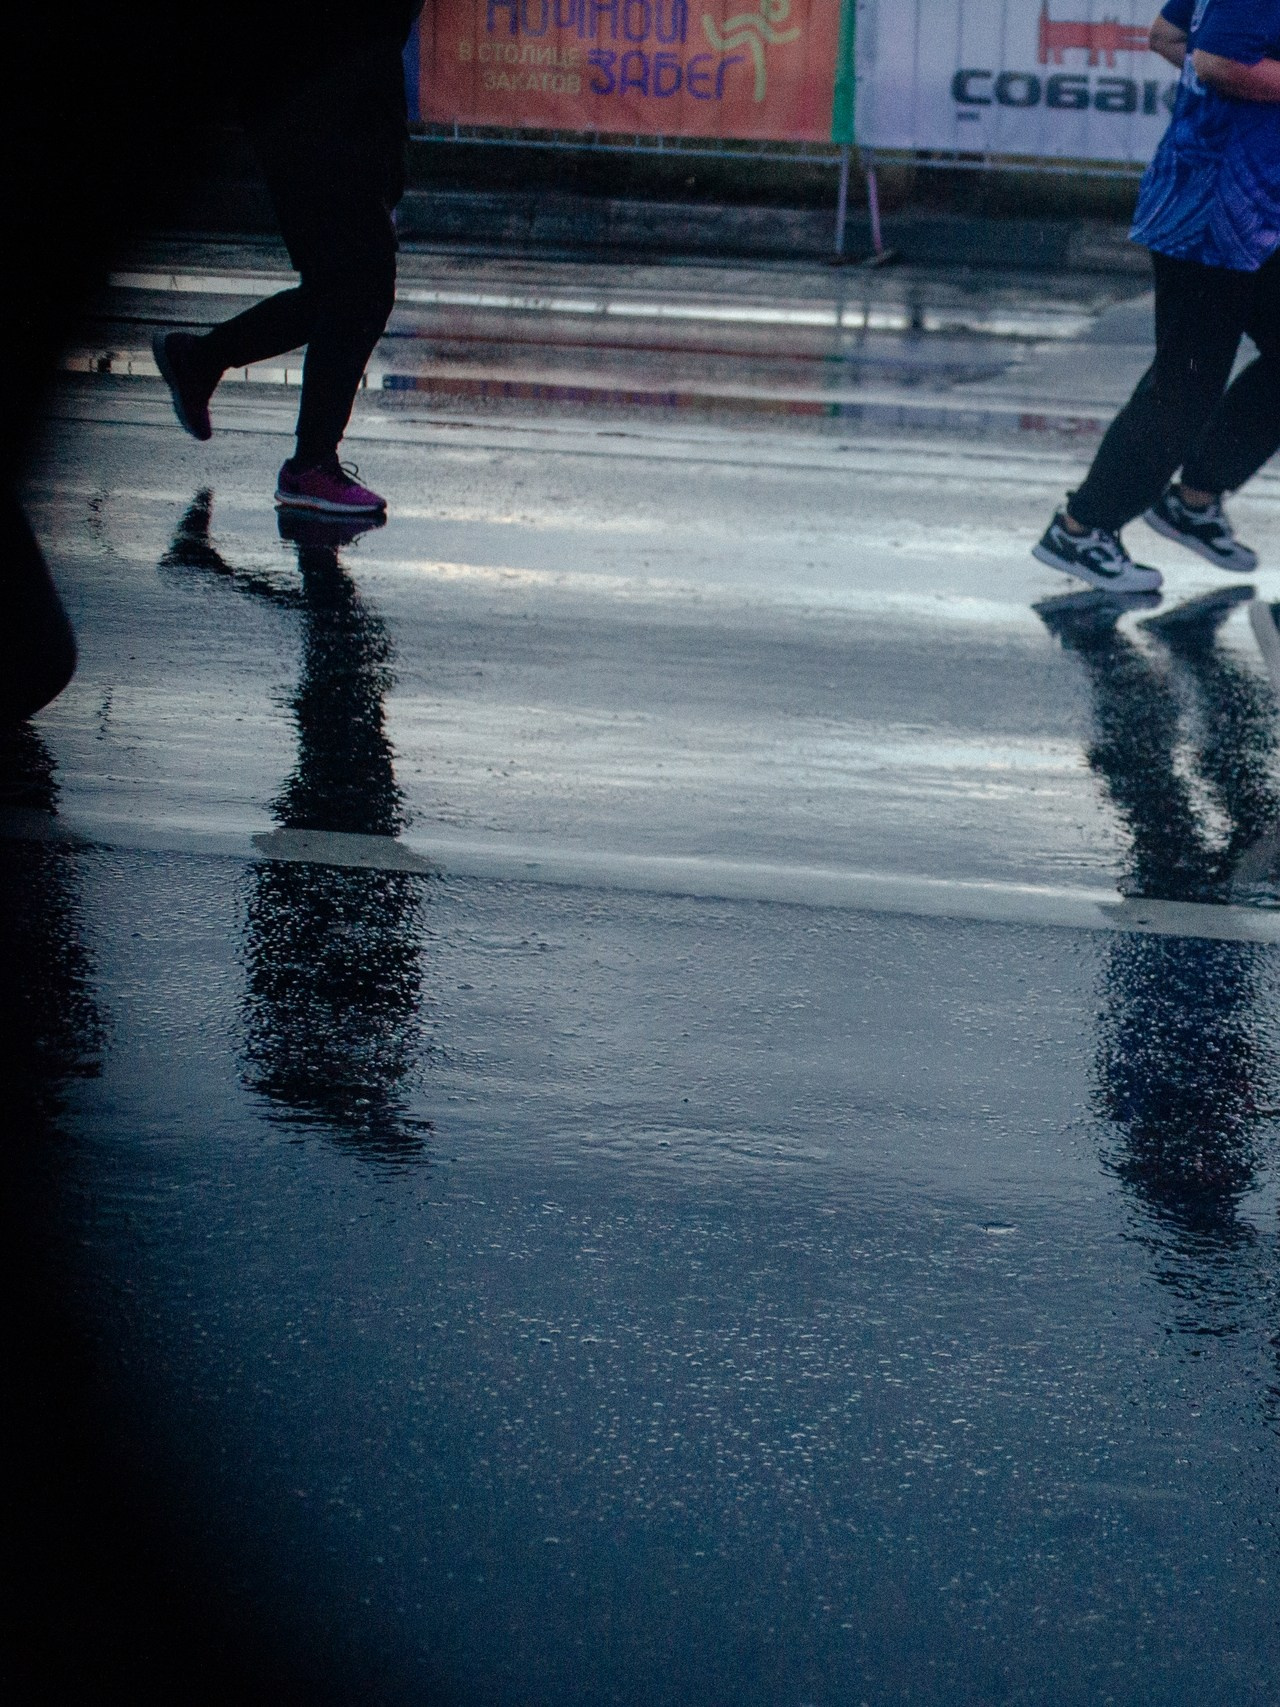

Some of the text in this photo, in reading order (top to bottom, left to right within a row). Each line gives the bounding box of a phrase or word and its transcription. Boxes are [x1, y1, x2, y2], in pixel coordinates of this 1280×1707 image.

[458, 41, 580, 68] В СТОЛИЦЕ
[483, 70, 581, 95] ЗАКАТОВ
[588, 48, 745, 99] ЗАБЕГ
